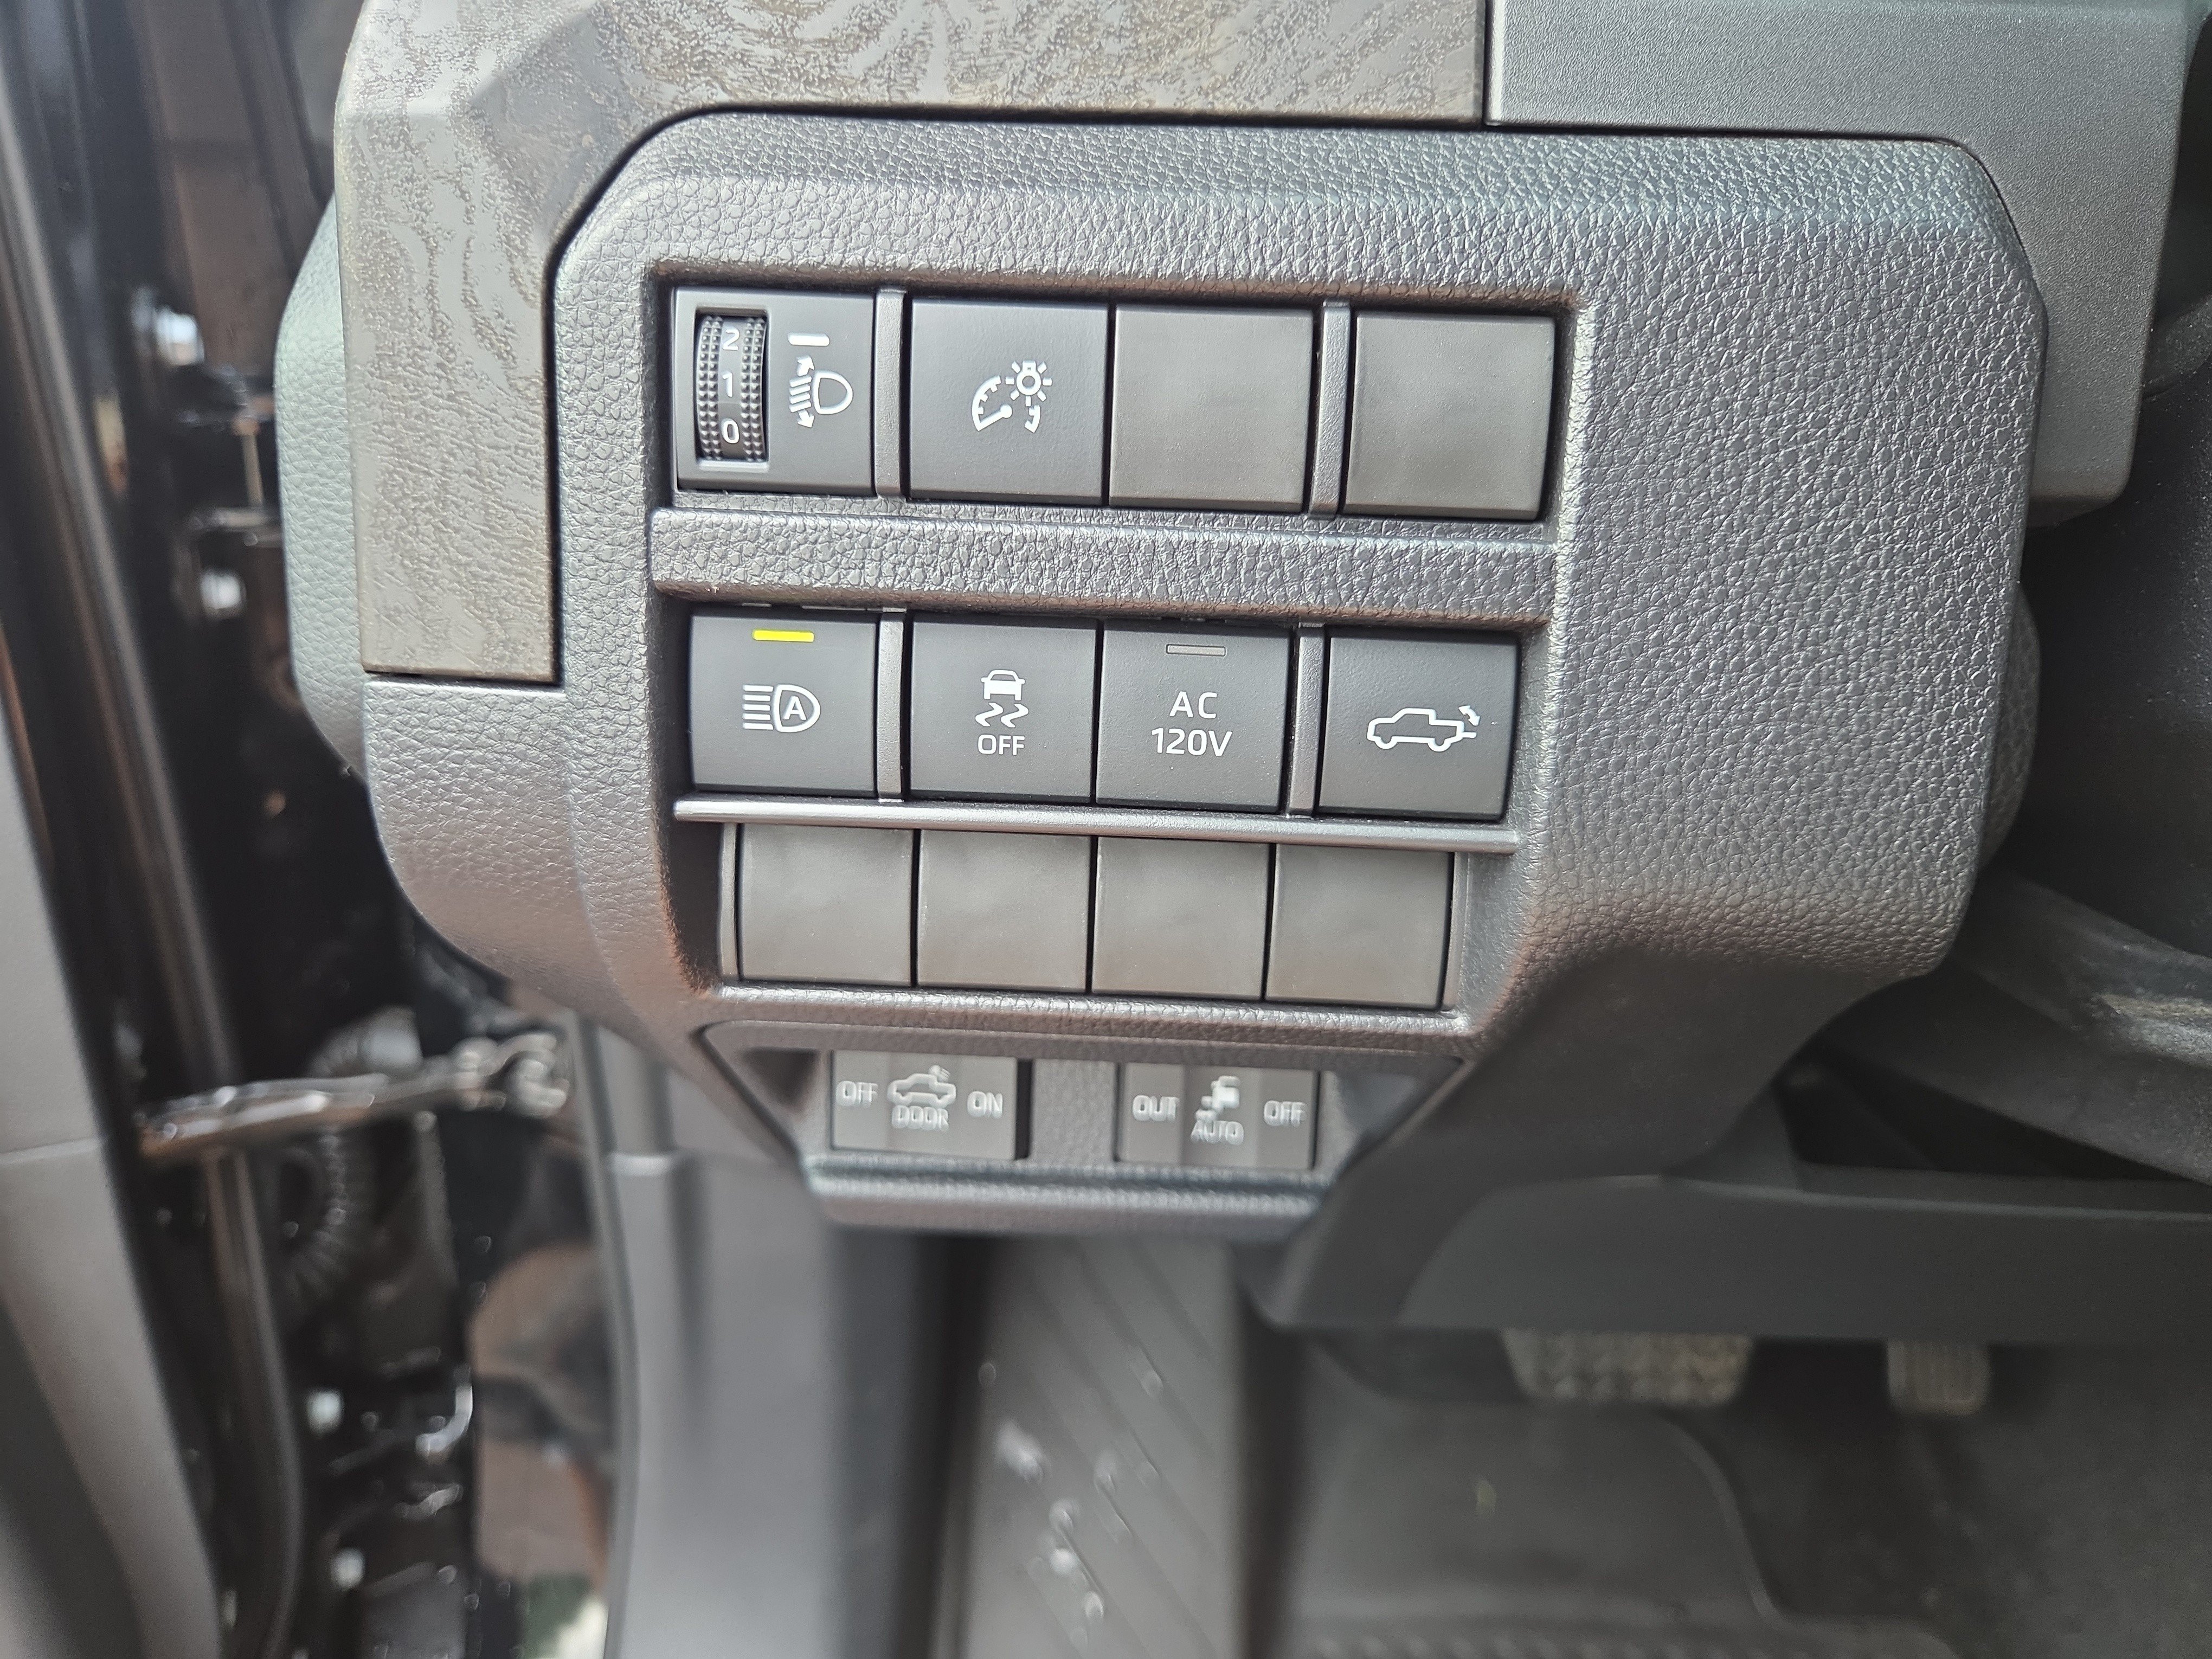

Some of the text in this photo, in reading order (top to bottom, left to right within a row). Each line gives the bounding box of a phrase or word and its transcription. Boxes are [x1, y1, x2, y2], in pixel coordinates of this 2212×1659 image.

[723, 329, 740, 351] 2
[722, 373, 734, 397] 1
[721, 419, 740, 444] 0
[782, 699, 808, 721] A
[1169, 691, 1218, 719] AC
[978, 734, 1026, 755] OFF
[1152, 727, 1233, 757] 120V
[836, 1081, 878, 1108] OFF
[967, 1091, 1003, 1118] ON
[891, 1105, 950, 1132] DOOR
[1263, 1099, 1307, 1128] OFF
[1191, 1120, 1245, 1146] AUTO
